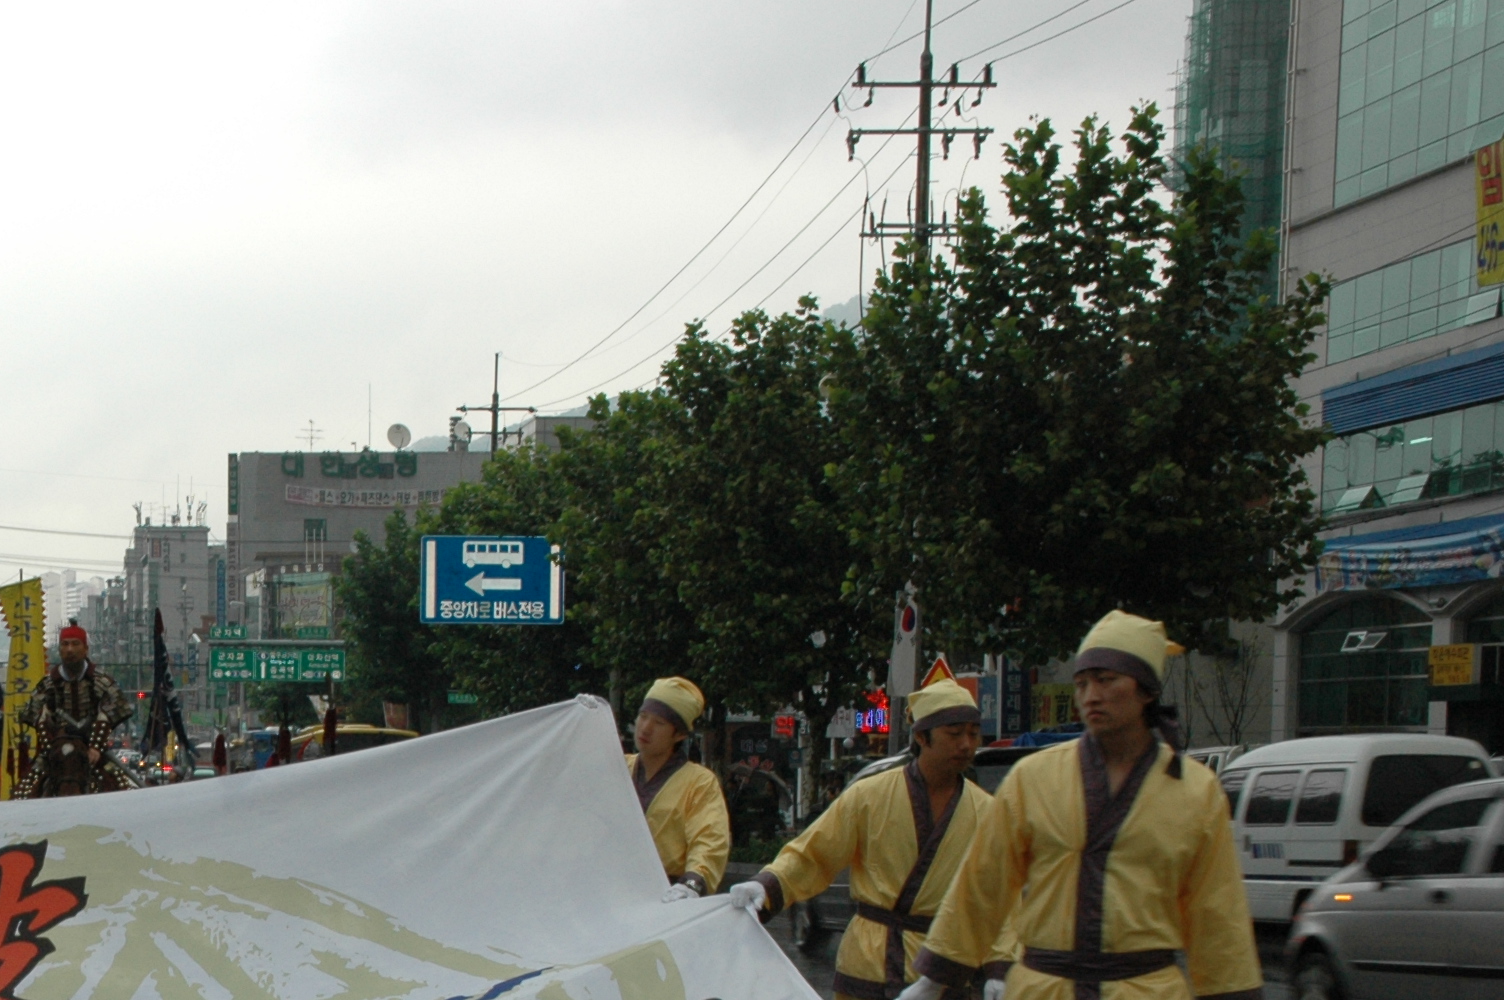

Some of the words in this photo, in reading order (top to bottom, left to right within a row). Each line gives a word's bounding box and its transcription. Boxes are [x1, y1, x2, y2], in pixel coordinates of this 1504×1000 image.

[281, 449, 418, 479] 대한생명
[439, 600, 491, 619] 중앙차로
[493, 600, 545, 619] 버스전용
